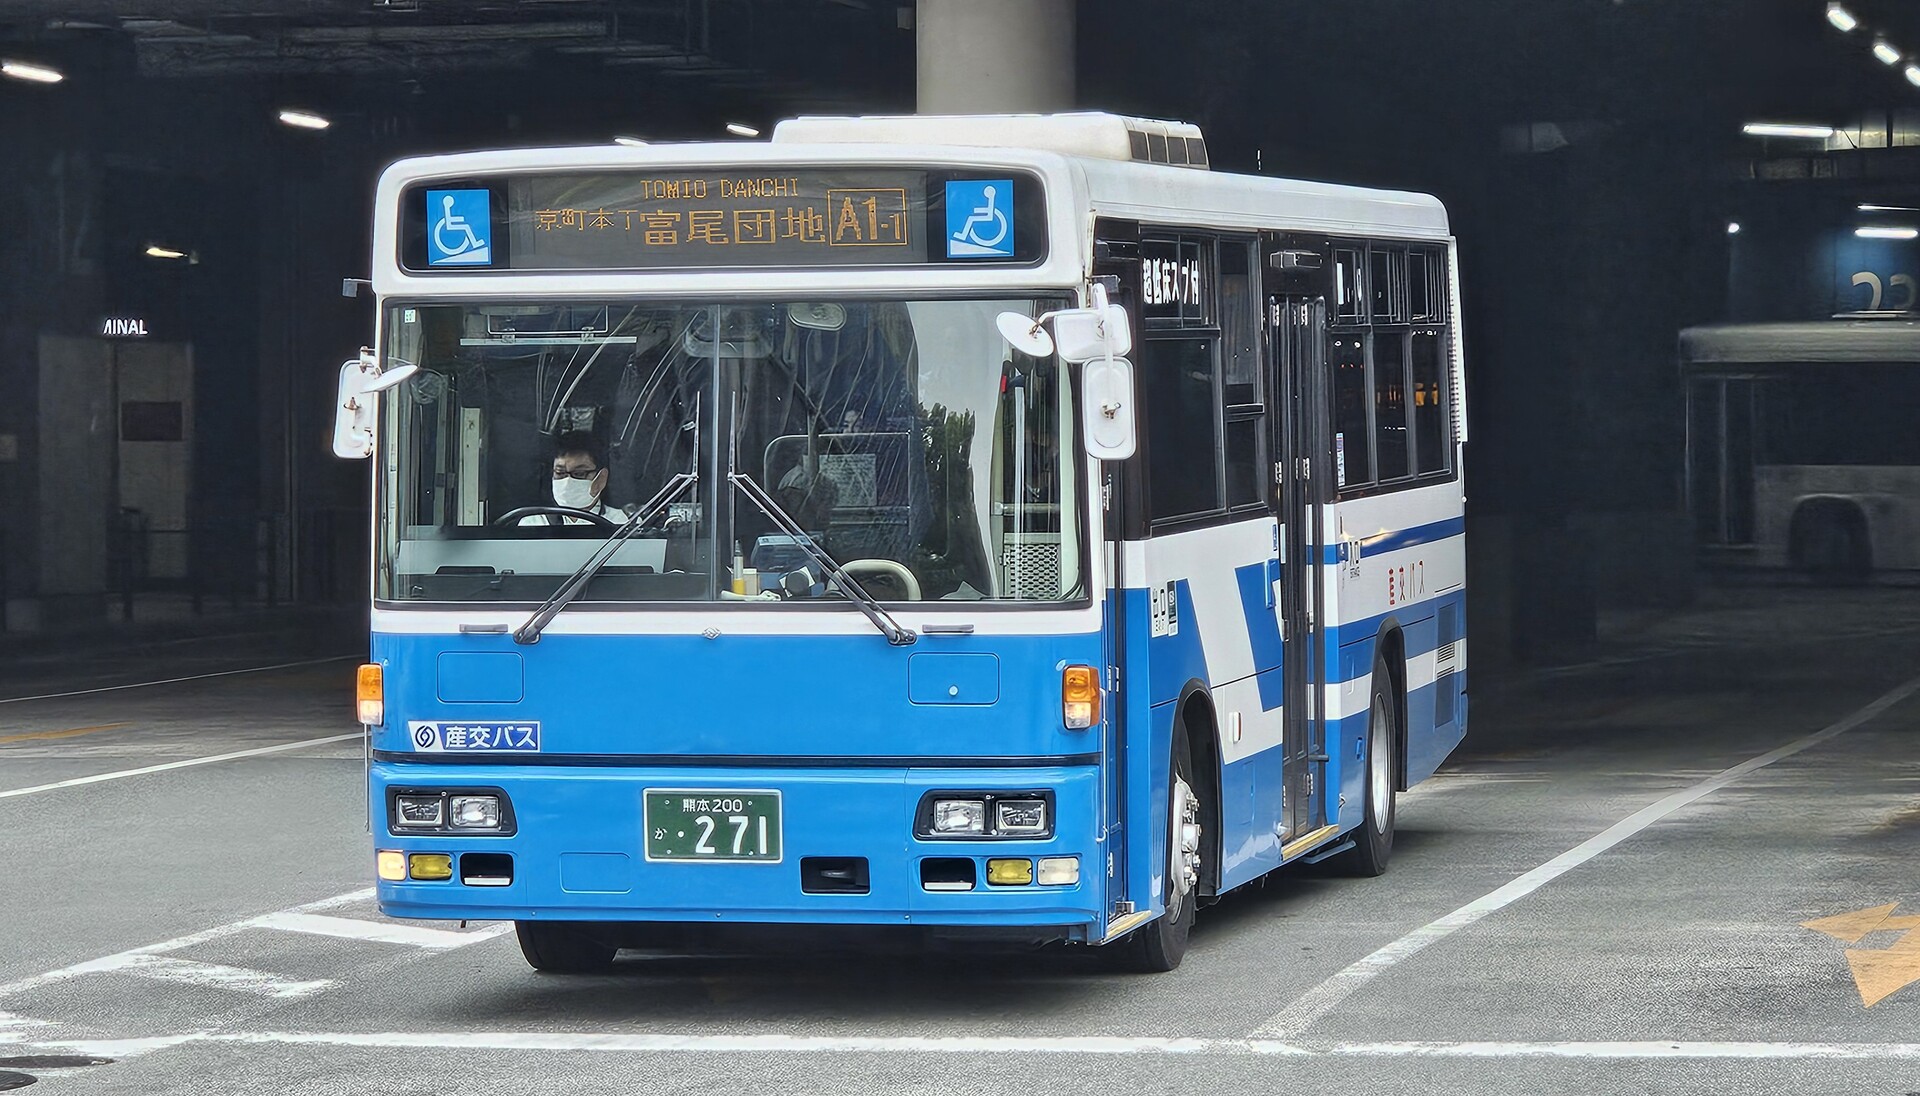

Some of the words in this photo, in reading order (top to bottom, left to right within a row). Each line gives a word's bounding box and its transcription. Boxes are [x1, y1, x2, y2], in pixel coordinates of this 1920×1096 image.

[640, 179, 707, 199] TOMIO
[719, 178, 799, 198] DANCHI
[639, 207, 826, 246] 富尾団地
[445, 725, 537, 749] 産交バス
